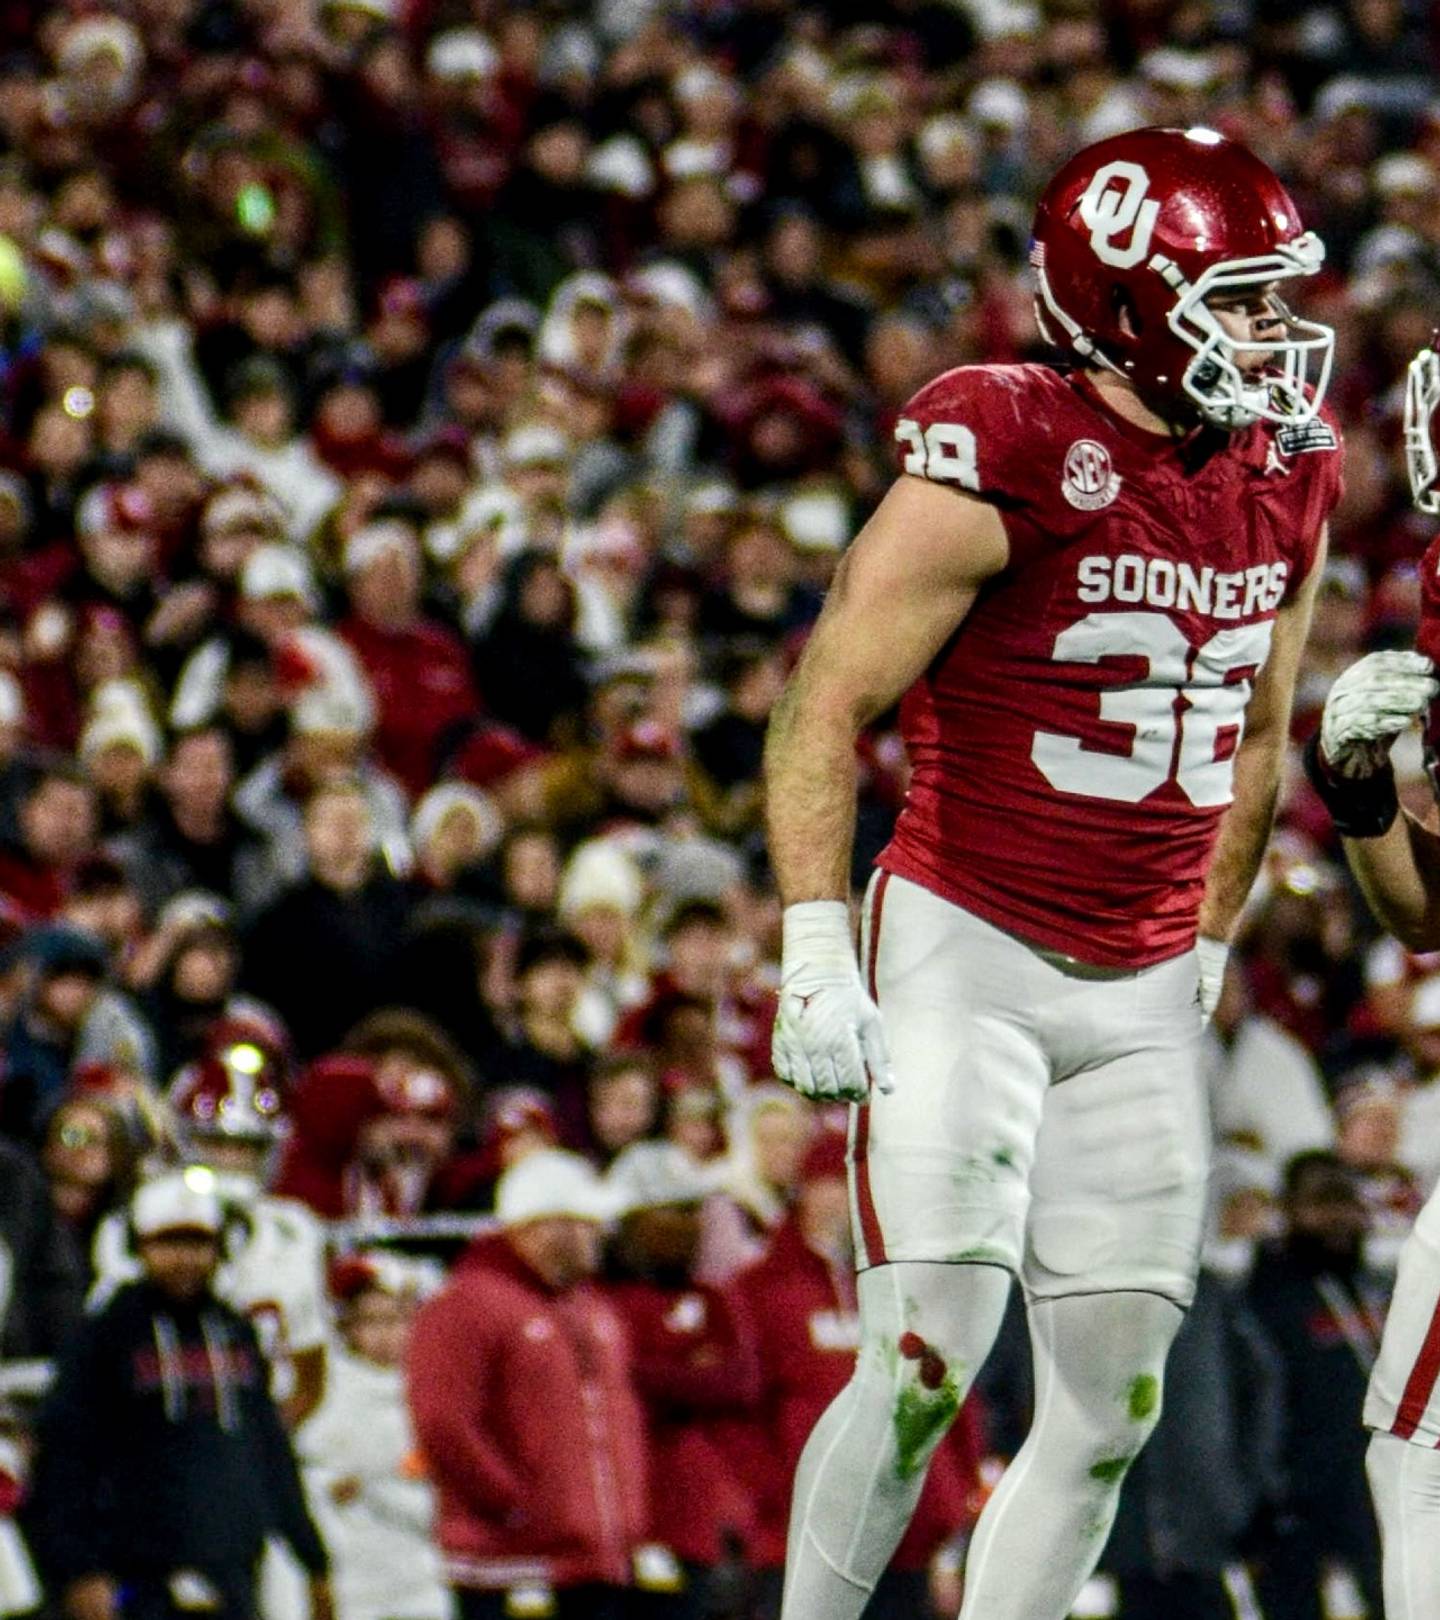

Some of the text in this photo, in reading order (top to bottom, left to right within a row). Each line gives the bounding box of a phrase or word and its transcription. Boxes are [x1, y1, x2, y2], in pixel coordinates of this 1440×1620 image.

[1079, 160, 1161, 270] OU
[1066, 442, 1109, 494] SEC
[1076, 553, 1288, 620] SOONERS
